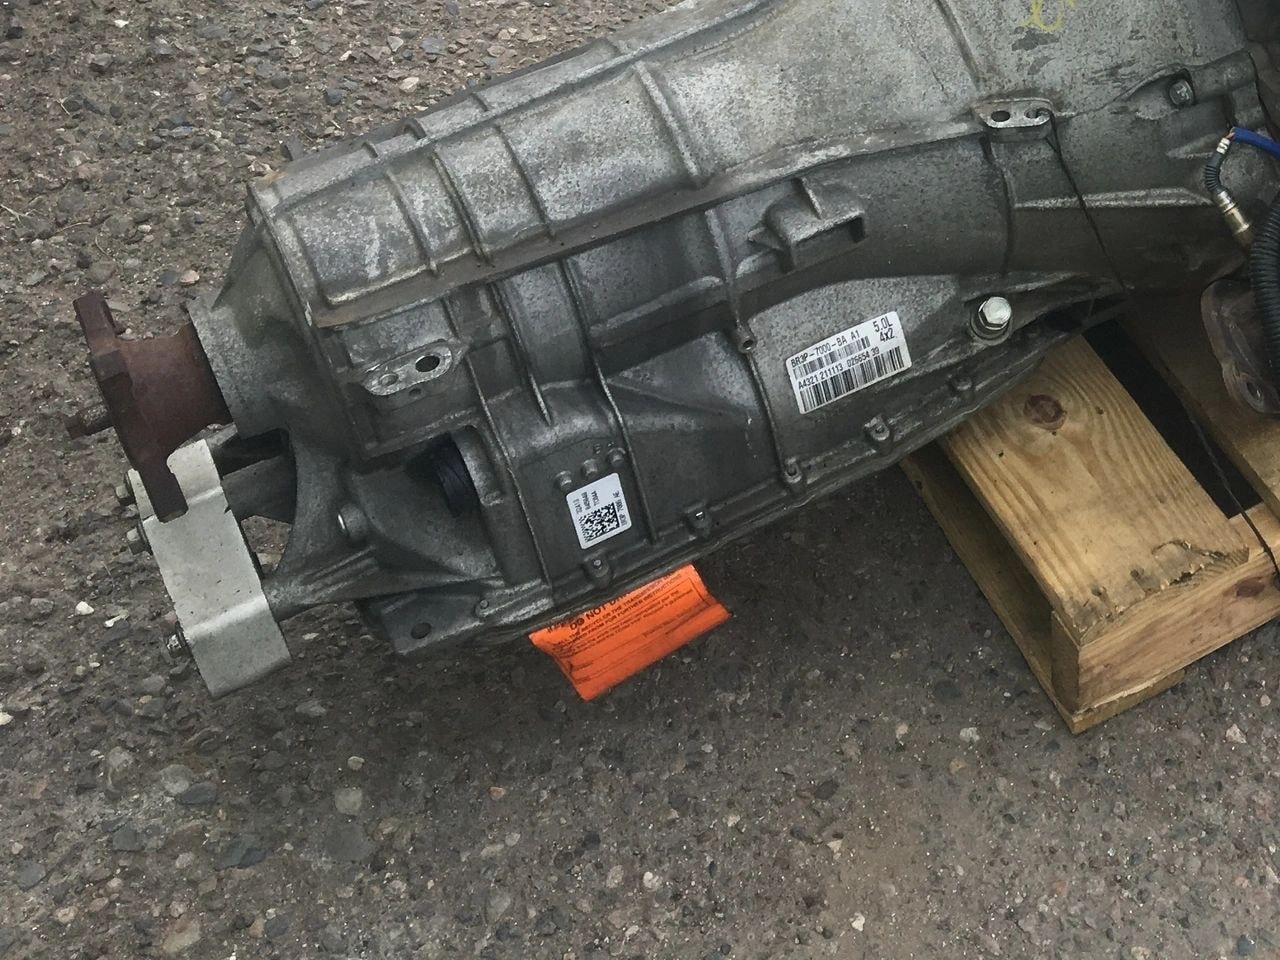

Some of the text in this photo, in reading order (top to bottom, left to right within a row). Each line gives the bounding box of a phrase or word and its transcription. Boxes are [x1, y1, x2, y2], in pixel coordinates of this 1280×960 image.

[872, 316, 893, 333] 5.0L
[851, 330, 860, 340] A1
[879, 328, 895, 343] 4x2
[798, 374, 819, 390] A4321
[820, 363, 844, 380] 211113
[570, 617, 585, 630] DO
[586, 605, 607, 620] NOT
